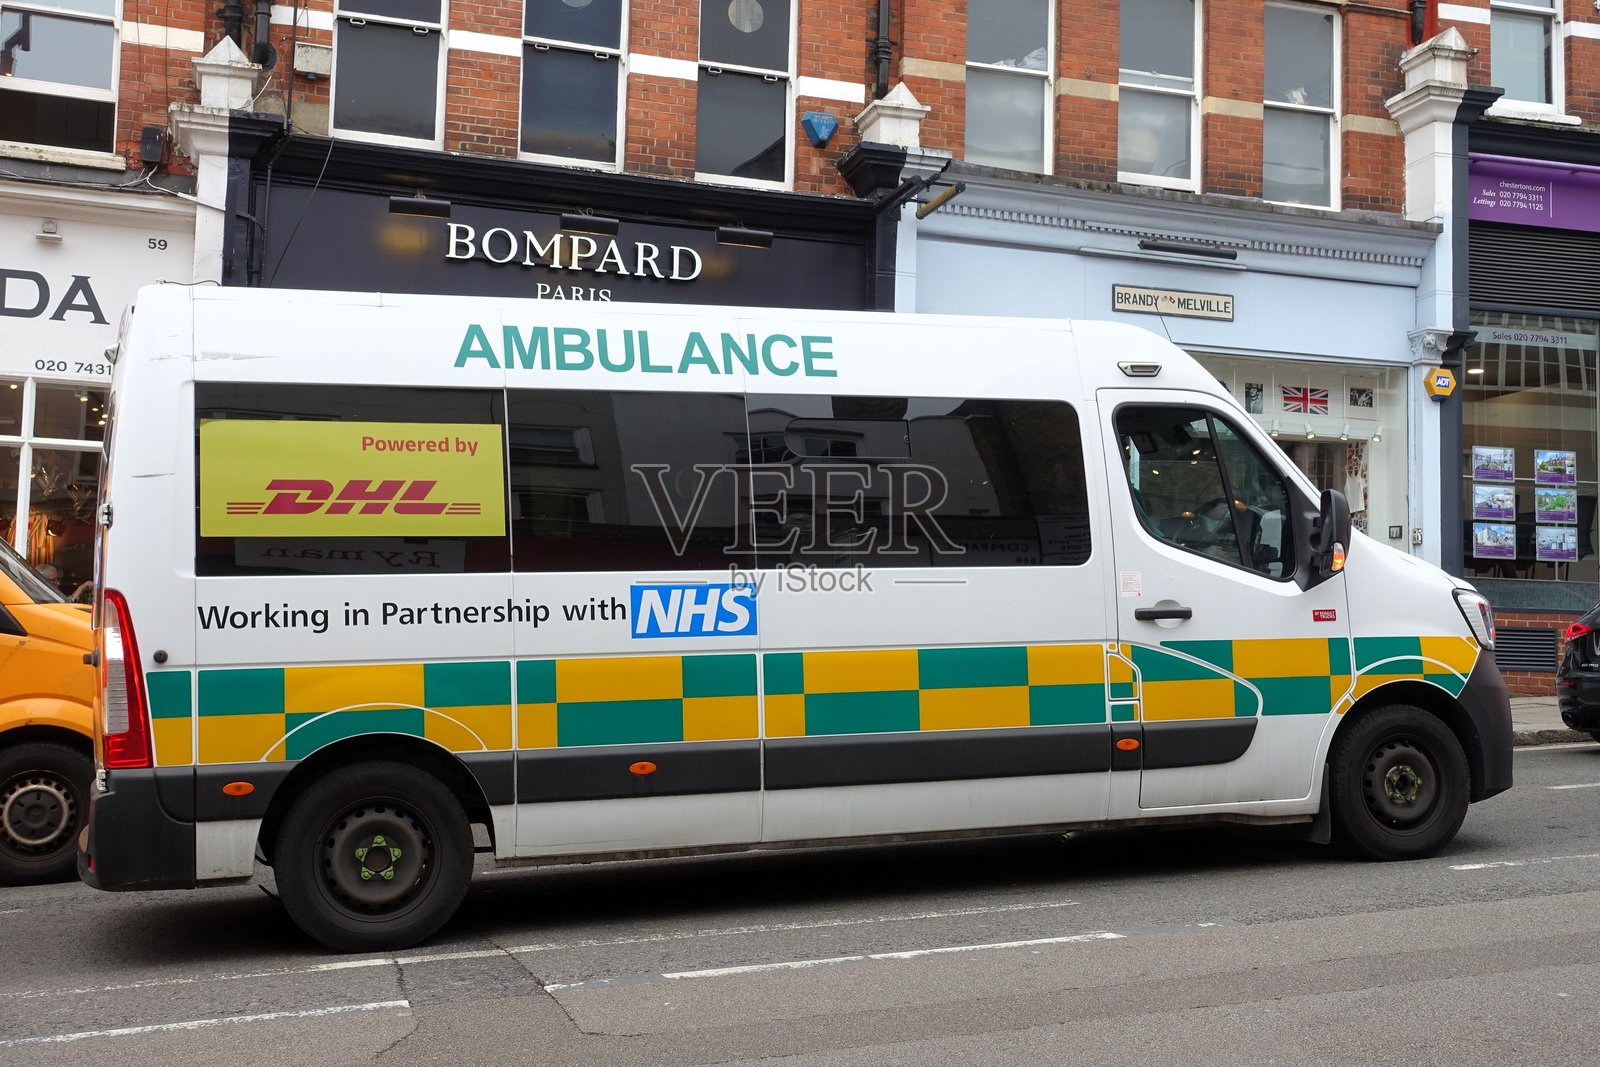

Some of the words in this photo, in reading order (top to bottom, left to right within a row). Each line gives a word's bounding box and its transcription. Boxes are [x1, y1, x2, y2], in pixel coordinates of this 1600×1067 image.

[1482, 189, 1496, 197] Sales
[1499, 190, 1511, 199] 020
[1512, 192, 1527, 200] 7794
[1528, 193, 1543, 202] 3311
[1499, 181, 1546, 192] chestertons.com
[1473, 197, 1496, 208] Lettings
[1499, 199, 1511, 207] 020
[1512, 200, 1527, 209] 7794
[1528, 203, 1544, 211] 1125
[147, 238, 168, 251] 59
[446, 222, 702, 282] BOMPARD
[536, 282, 612, 302] PARIS
[1116, 291, 1160, 307] BRANDY
[1177, 297, 1232, 314] MELVILLE
[1492, 331, 1512, 341] Sales
[1513, 333, 1528, 342] 020
[1530, 334, 1549, 344] 7794
[1550, 335, 1568, 345] 3311
[453, 323, 839, 379] AMBULANCE
[34, 359, 68, 372] 020
[74, 362, 113, 376] 7431
[1436, 377, 1450, 388] ADT
[361, 435, 450, 453] Powered
[454, 437, 479, 457] by
[261, 479, 449, 515] DHL
[197, 602, 329, 634] Working
[344, 602, 369, 627] in
[382, 598, 550, 629] Partnership
[562, 597, 627, 622] with
[635, 587, 753, 634] NHS
